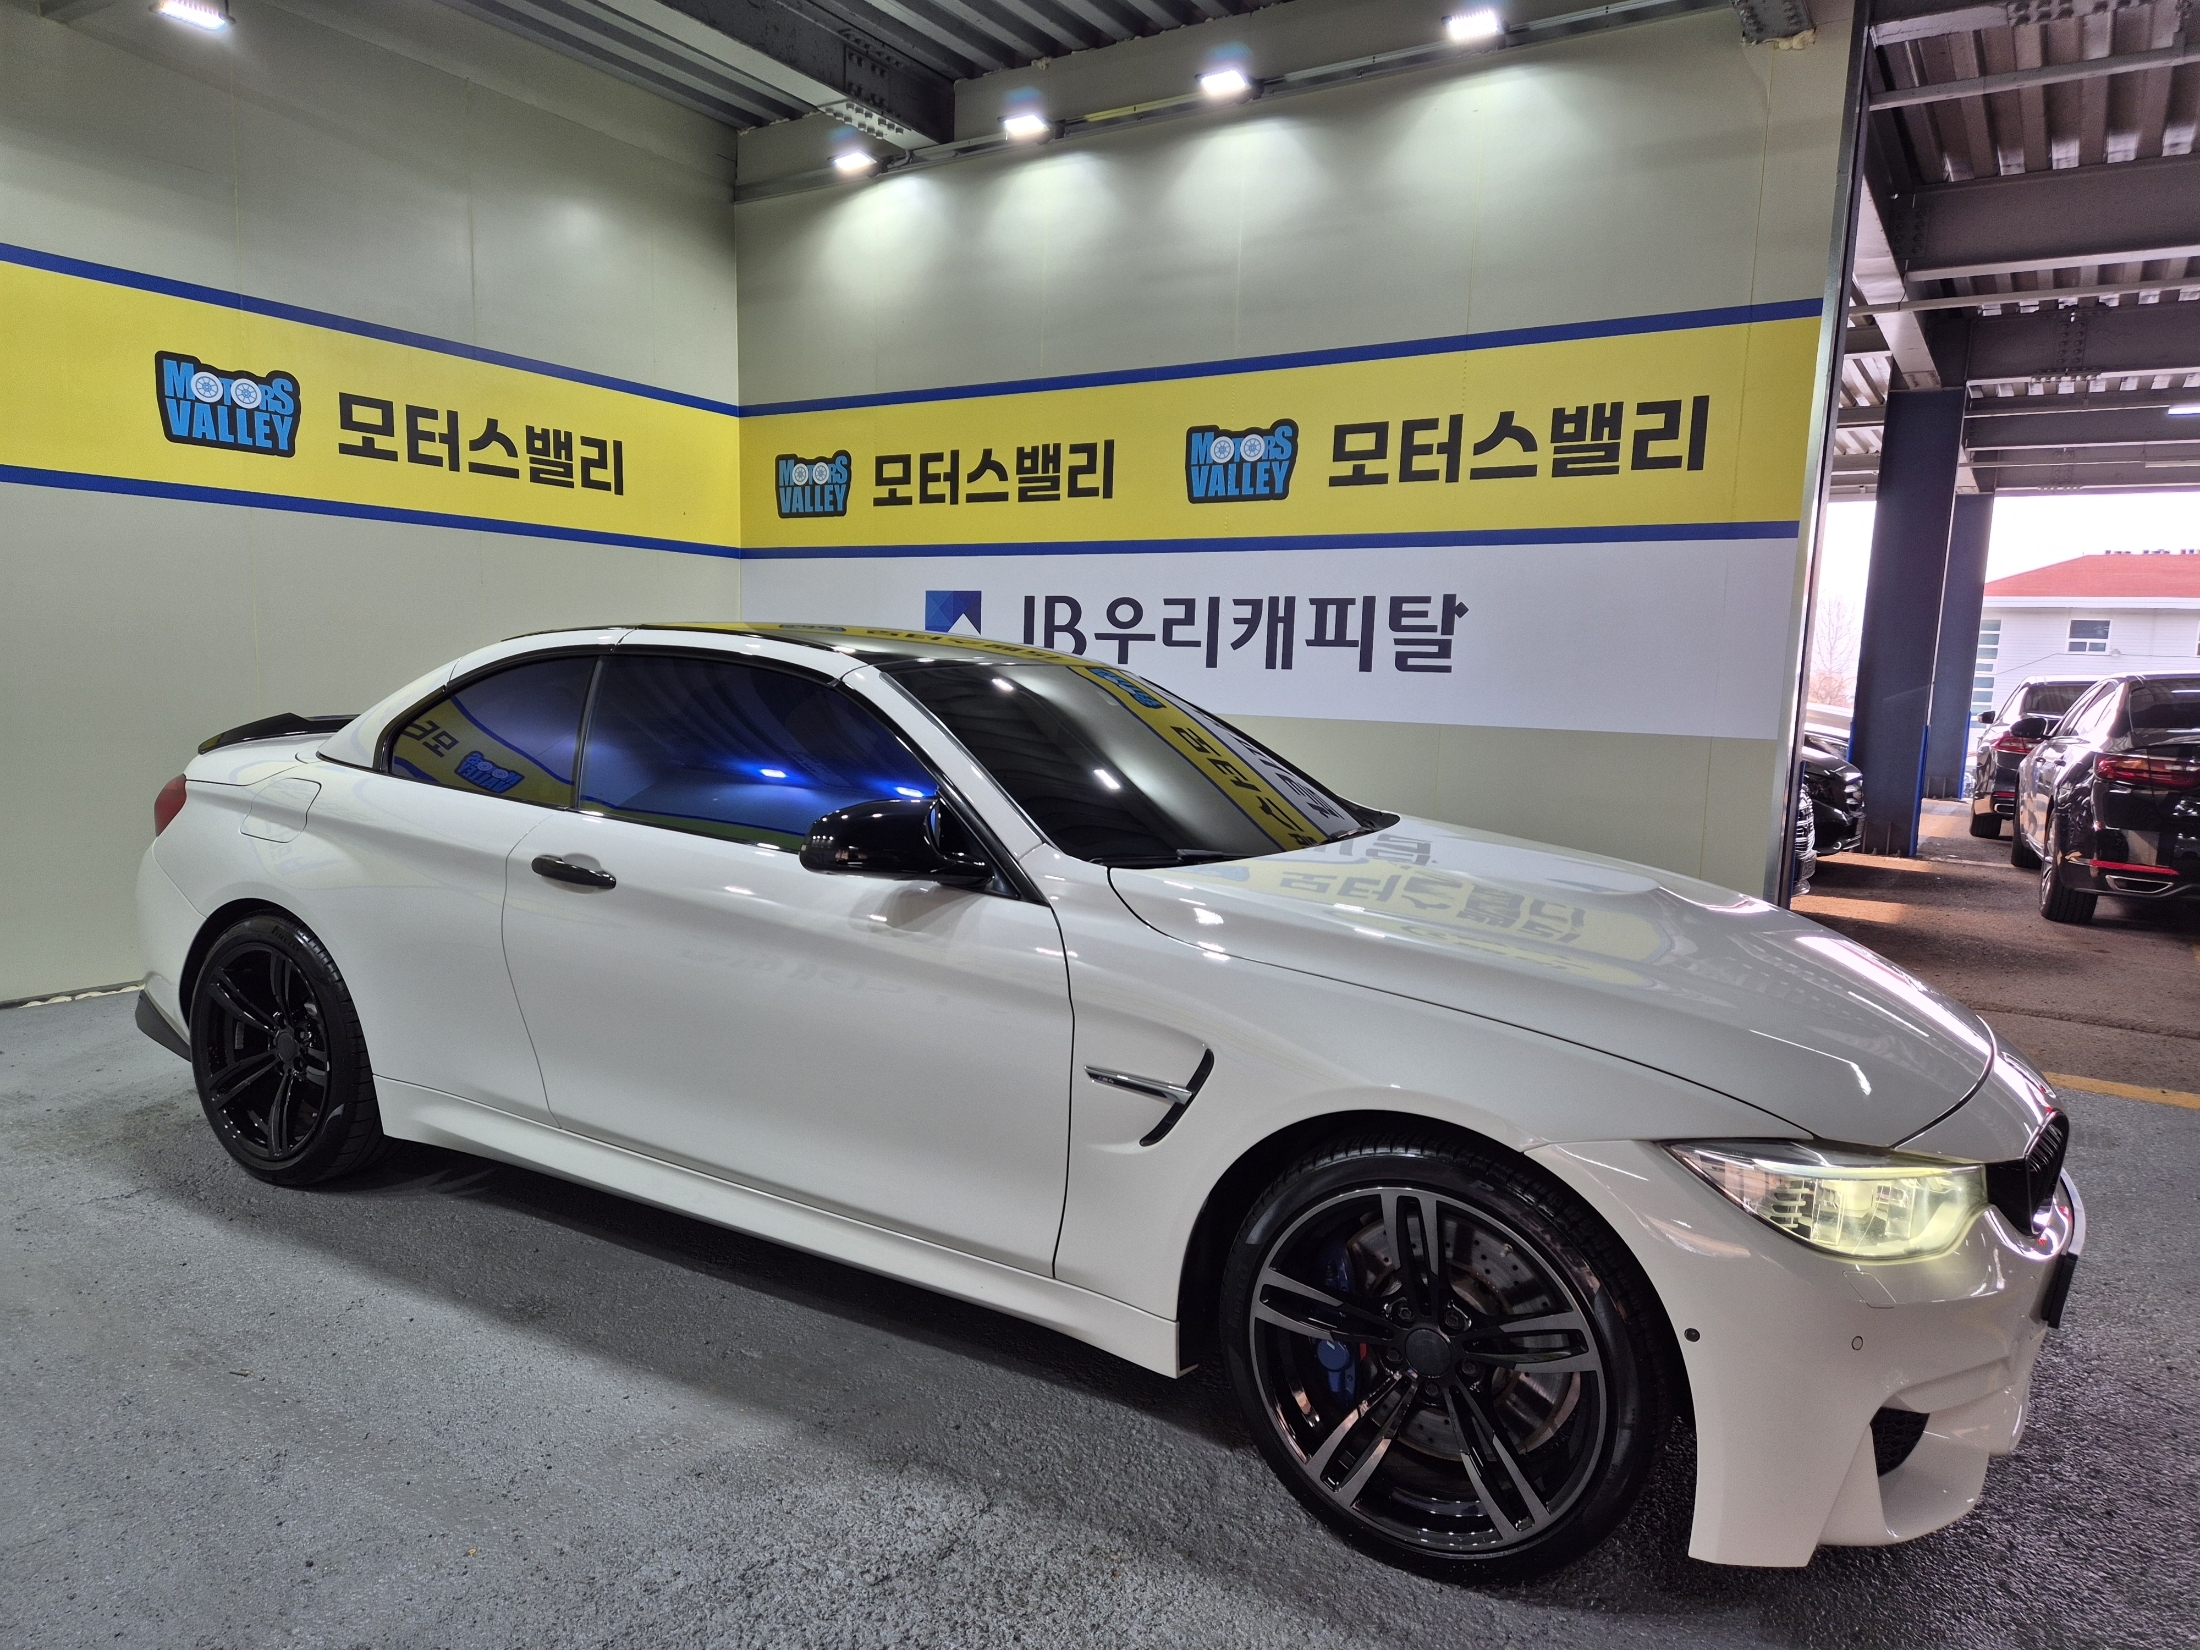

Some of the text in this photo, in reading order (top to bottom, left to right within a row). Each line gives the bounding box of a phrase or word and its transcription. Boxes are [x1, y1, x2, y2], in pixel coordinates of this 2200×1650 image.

[166, 398, 292, 450] VALLEY
[338, 391, 624, 495] 모터스밸리
[1328, 395, 1710, 487] 모터스밸리
[779, 484, 846, 513] VALLEY
[873, 439, 1115, 506] 모터스밸리
[1191, 461, 1290, 498] VALLEY
